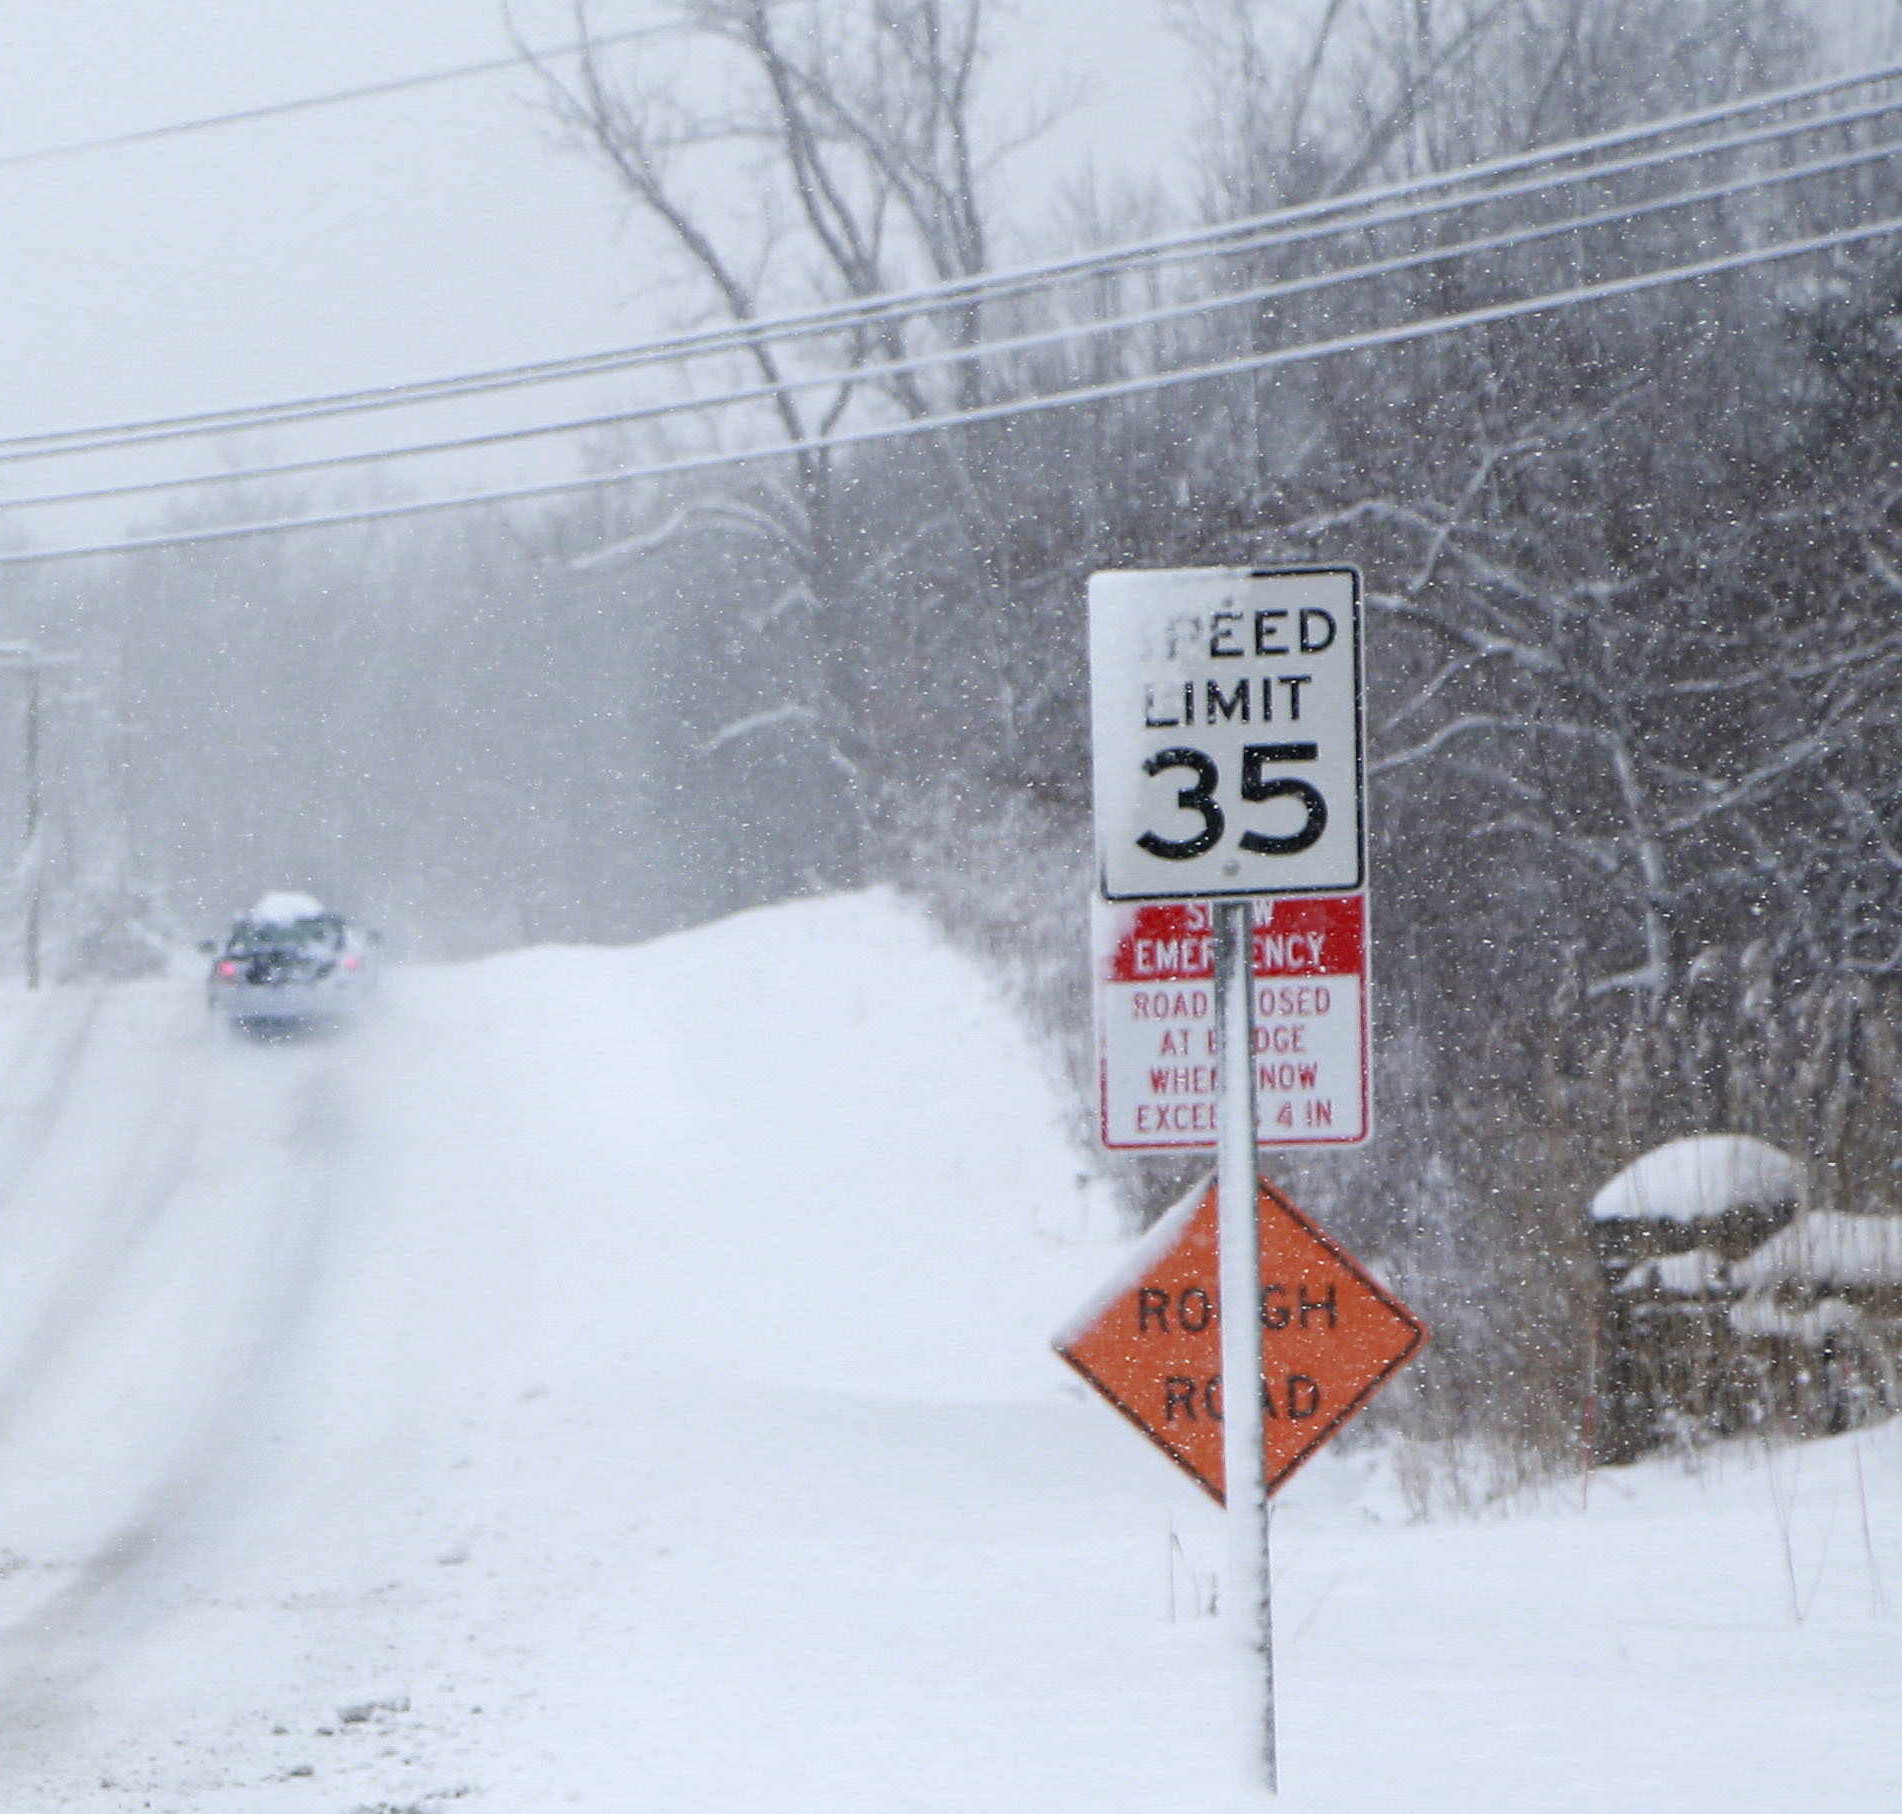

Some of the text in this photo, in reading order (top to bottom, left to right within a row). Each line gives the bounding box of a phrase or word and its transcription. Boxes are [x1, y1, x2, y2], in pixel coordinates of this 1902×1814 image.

[1146, 607, 1338, 659] PEED
[1145, 673, 1313, 728] LIMIT
[1135, 741, 1329, 861] 35
[1186, 901, 1275, 930] SW
[1134, 933, 1326, 974] EMERENCY
[1132, 986, 1332, 1020] ROAD OSED
[1161, 1028, 1192, 1057] AT
[1258, 1061, 1318, 1091] NOW
[1276, 1100, 1293, 1128] 4
[1306, 1098, 1333, 1128] IN
[1138, 1283, 1338, 1335] ROGH
